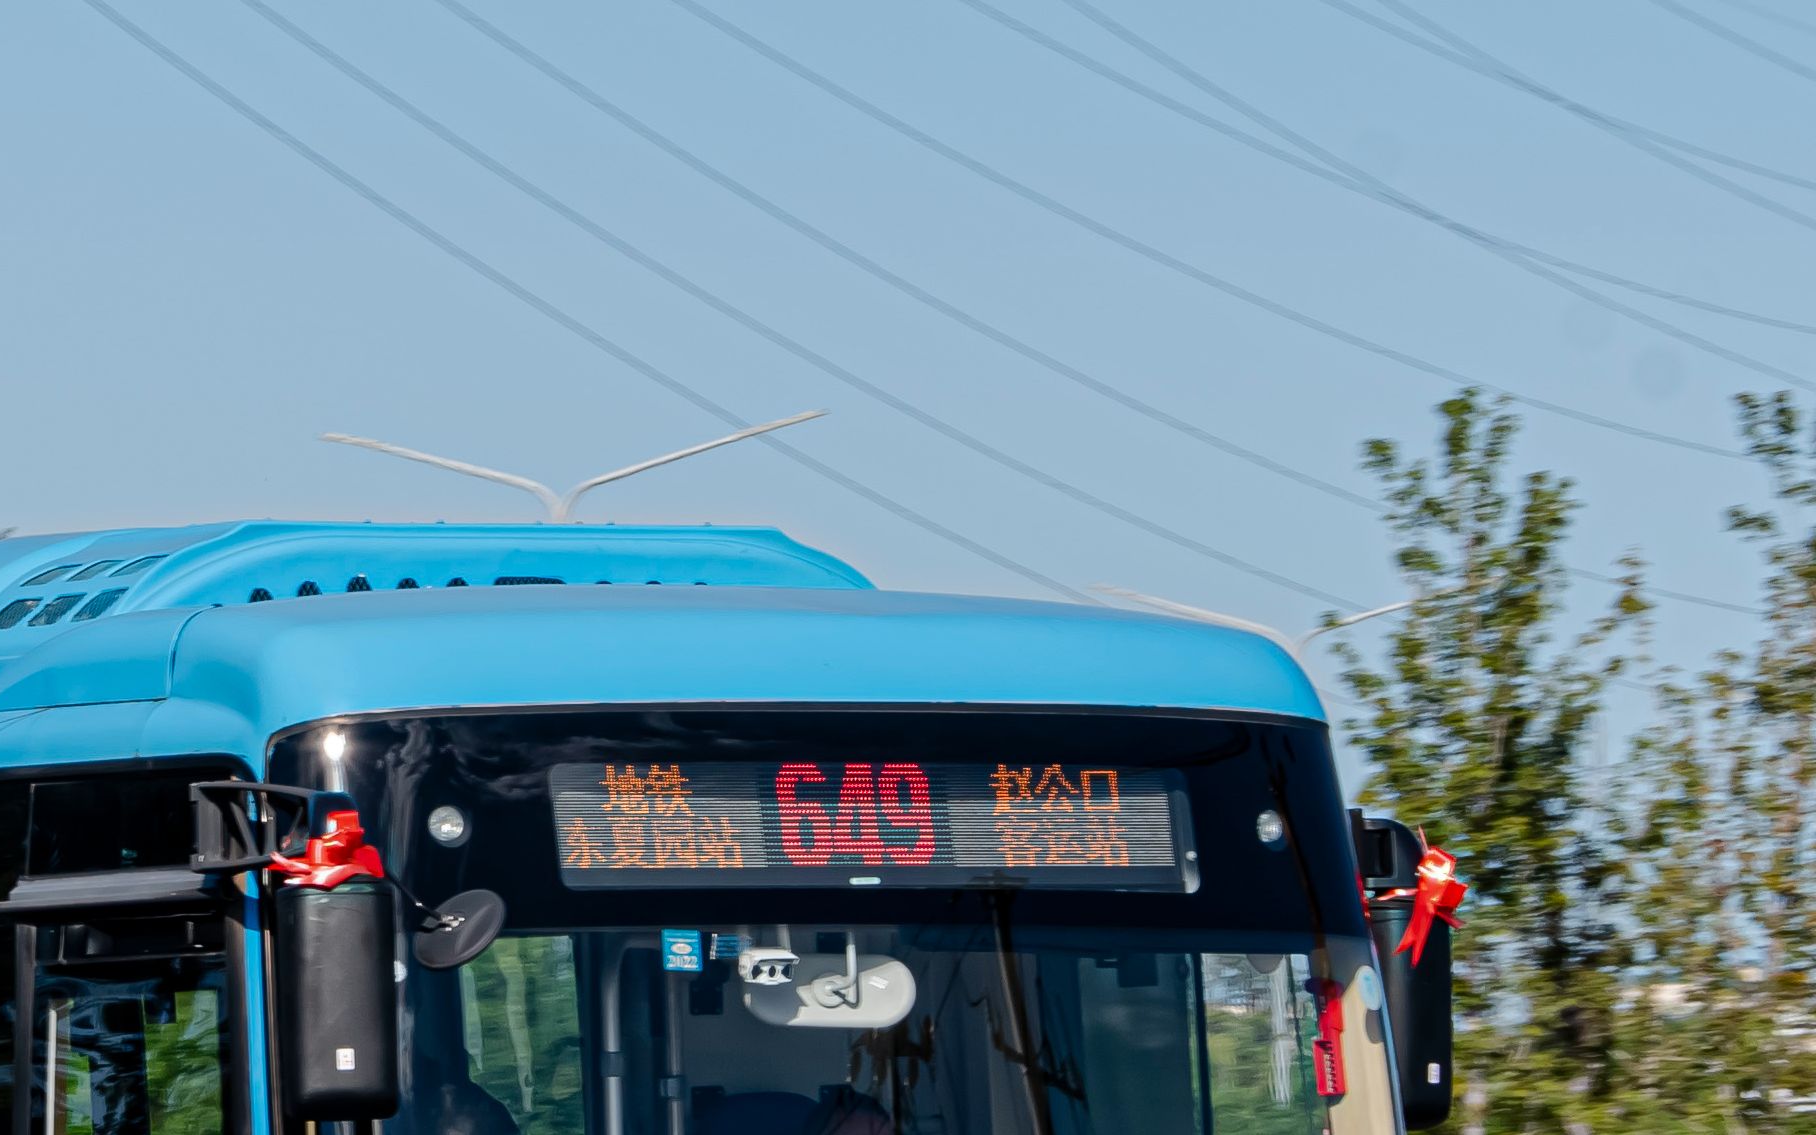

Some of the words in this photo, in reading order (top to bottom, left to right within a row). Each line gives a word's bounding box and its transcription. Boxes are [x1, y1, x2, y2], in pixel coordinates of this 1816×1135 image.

[599, 764, 695, 816] 地铁
[775, 763, 936, 866] 649
[989, 763, 1121, 816] 赵公口
[564, 816, 745, 869] 东夏园站
[993, 815, 1129, 867] 客运站
